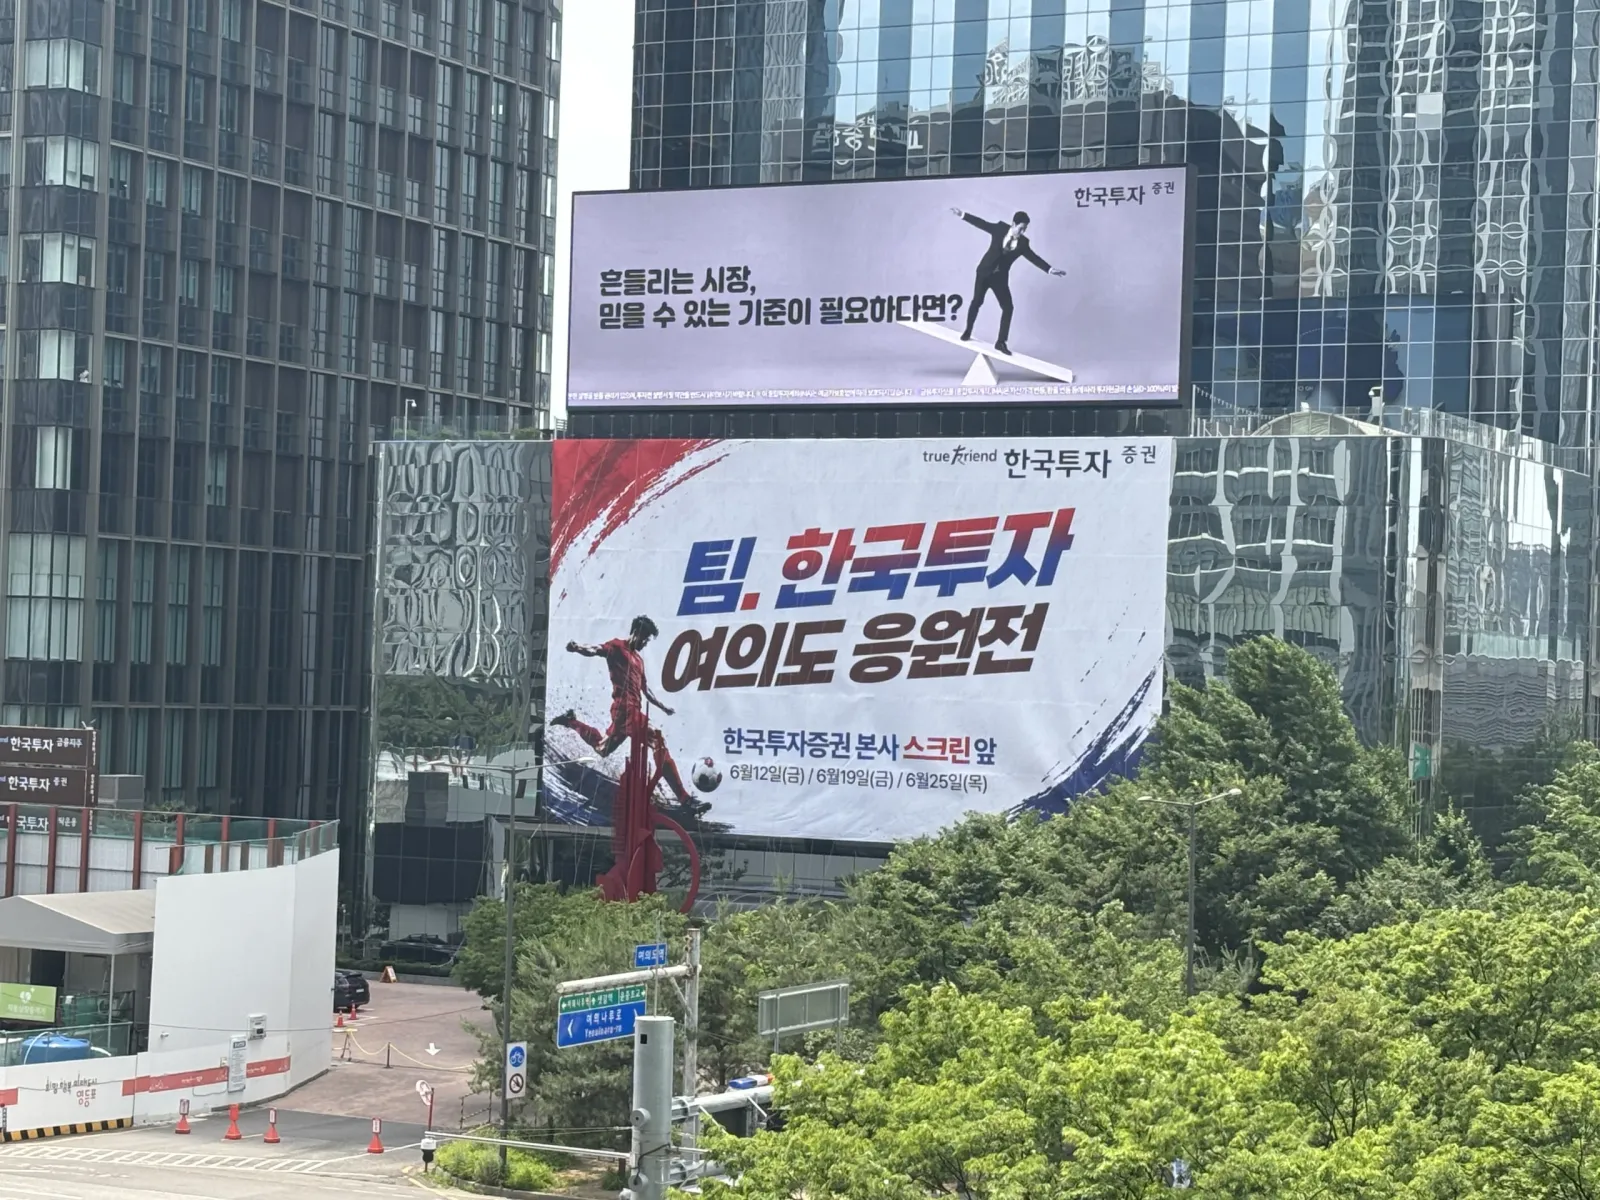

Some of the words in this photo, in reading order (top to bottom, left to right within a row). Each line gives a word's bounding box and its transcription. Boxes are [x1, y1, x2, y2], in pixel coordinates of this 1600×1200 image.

[1074, 185, 1146, 208] 한국투자
[1152, 181, 1175, 195] 증권
[600, 268, 694, 296] 흔들리는
[700, 265, 756, 296] 시장,
[600, 302, 645, 329] 믿을
[653, 301, 676, 328] 수
[684, 298, 731, 328] 있는
[738, 298, 811, 326] 기준이
[819, 294, 963, 325] 필요하다면?
[1004, 448, 1112, 478] 한국투자
[1121, 445, 1156, 464] 증권
[677, 537, 761, 616] 팀.
[775, 507, 1076, 610] 한국투자
[661, 619, 846, 693] 여의도
[849, 602, 1050, 684] 응원전
[10, 736, 54, 753] 한국투자
[56, 737, 83, 748] 금융지주
[723, 728, 851, 759] 한국투자증권
[855, 733, 899, 761] 본사
[903, 736, 970, 765] 스크린
[974, 738, 997, 765] 앞
[8, 776, 50, 792] 한국투자
[53, 777, 68, 787] 증권
[730, 765, 805, 785] 6월12일(금)
[816, 768, 894, 789] 6월19일(금)
[906, 771, 988, 794] 6월25일(목)
[7, 815, 49, 831] 국투자
[638, 949, 665, 962] 여의도역
[586, 1009, 622, 1025] 여의나루로
[76, 1088, 97, 1107] 영등포
